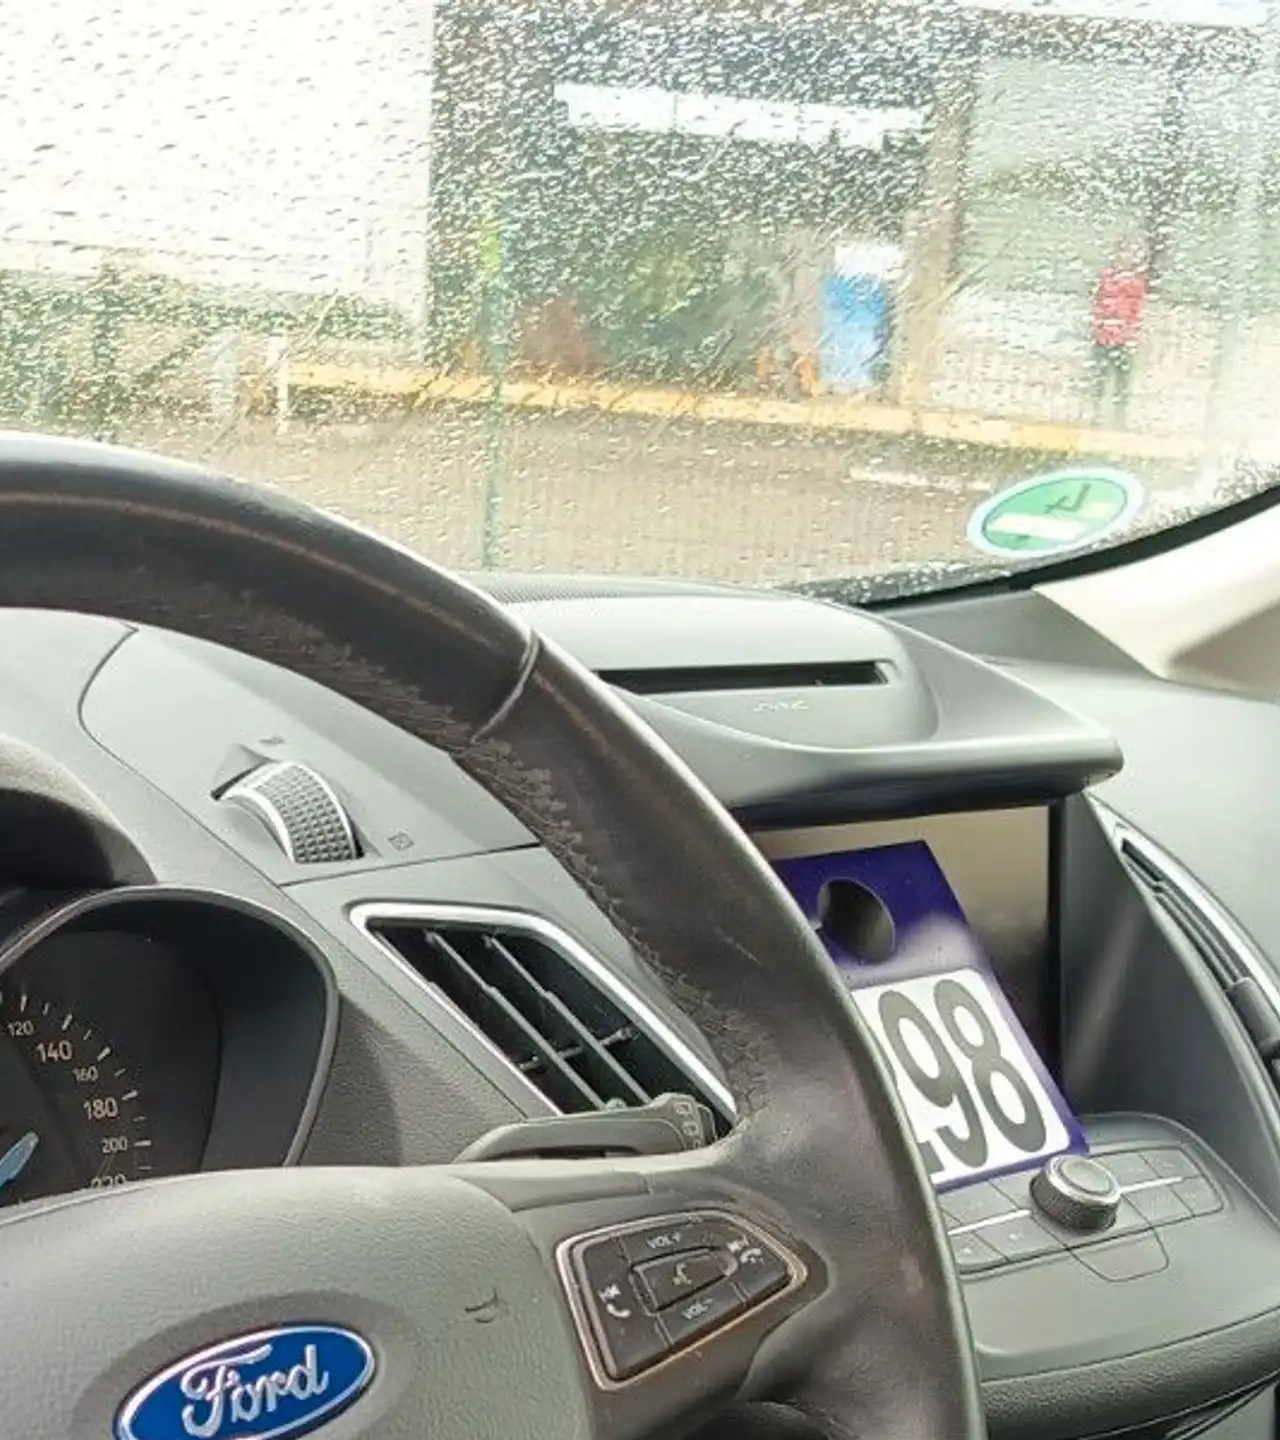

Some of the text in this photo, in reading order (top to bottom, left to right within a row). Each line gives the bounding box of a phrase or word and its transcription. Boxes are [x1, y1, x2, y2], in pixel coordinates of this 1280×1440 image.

[7, 1019, 35, 1037] 120
[36, 1040, 72, 1063] 140
[72, 1065, 99, 1082] 160
[877, 978, 1047, 1169] 98
[83, 1097, 118, 1120] 180
[102, 1135, 128, 1154] 200
[180, 1343, 330, 1439] Ford
